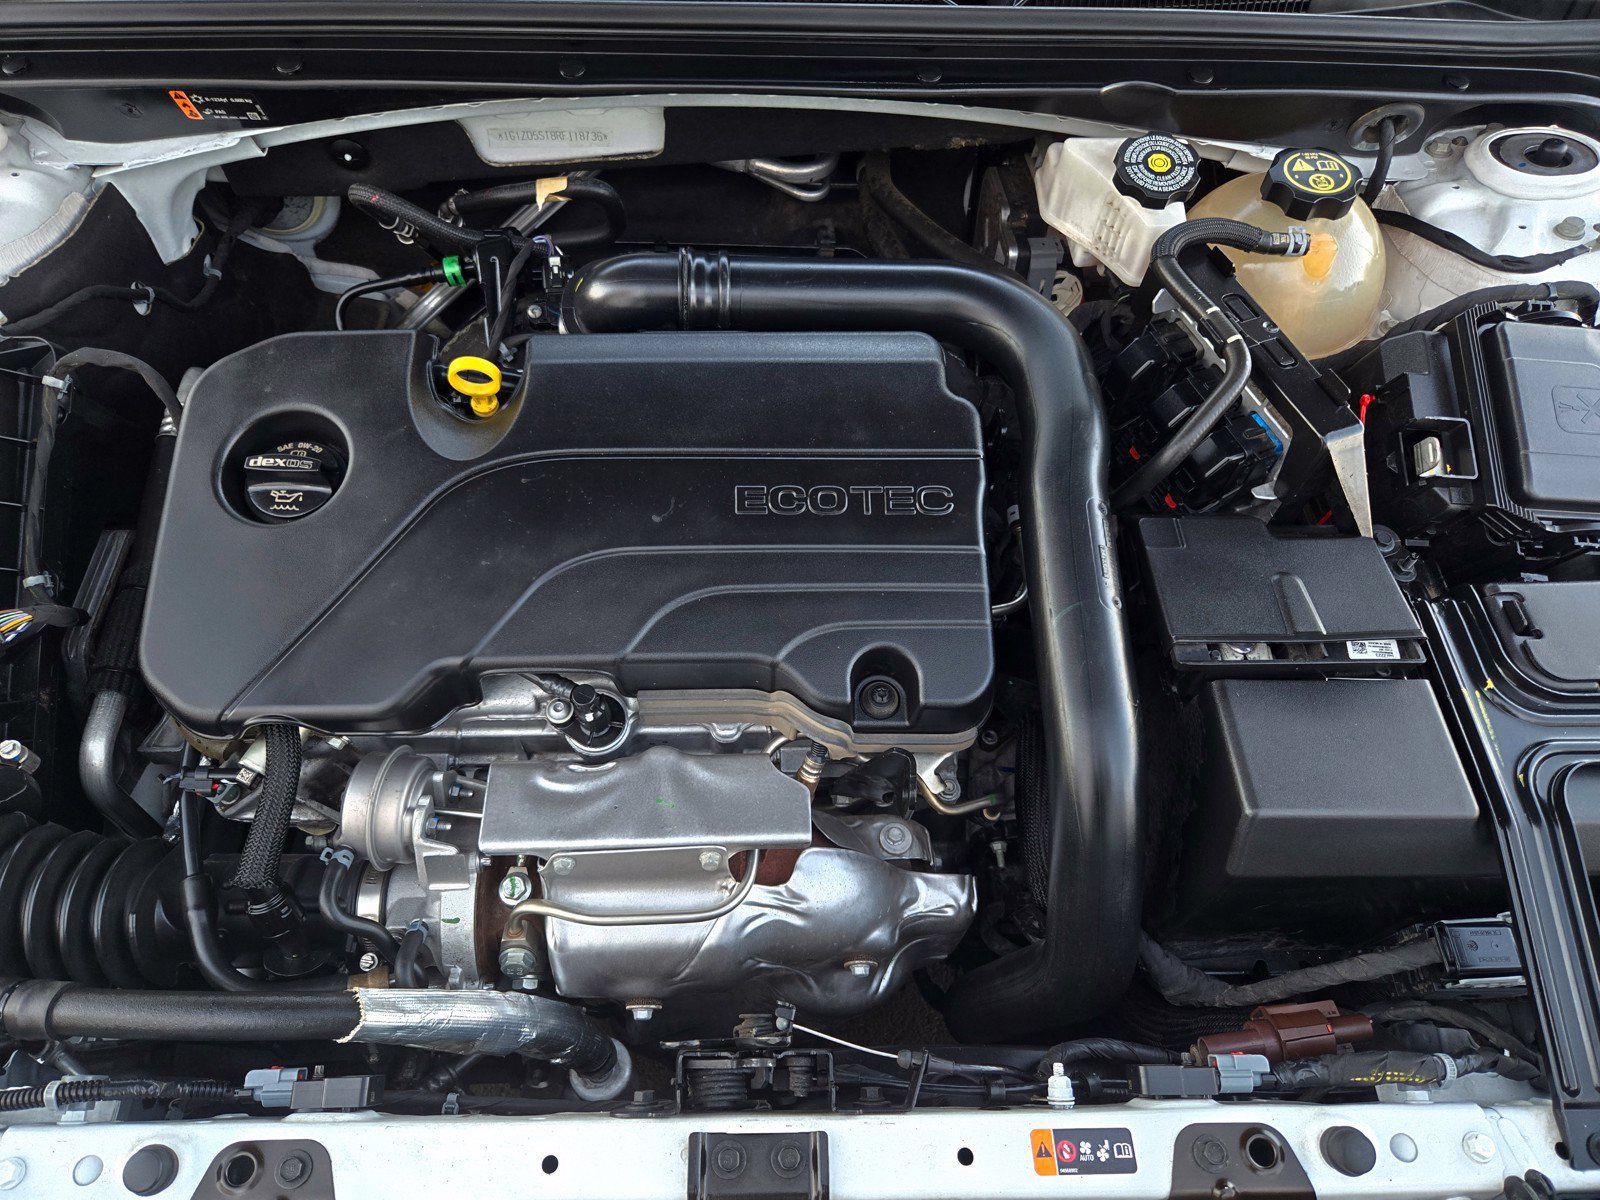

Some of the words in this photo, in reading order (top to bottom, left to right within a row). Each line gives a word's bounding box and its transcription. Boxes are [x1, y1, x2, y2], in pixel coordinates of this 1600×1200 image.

[277, 443, 294, 453] SAE
[297, 442, 324, 454] 0W-20
[249, 456, 314, 469] dexos
[734, 485, 955, 515] ECOTEC
[1080, 1154, 1095, 1162] AUTO
